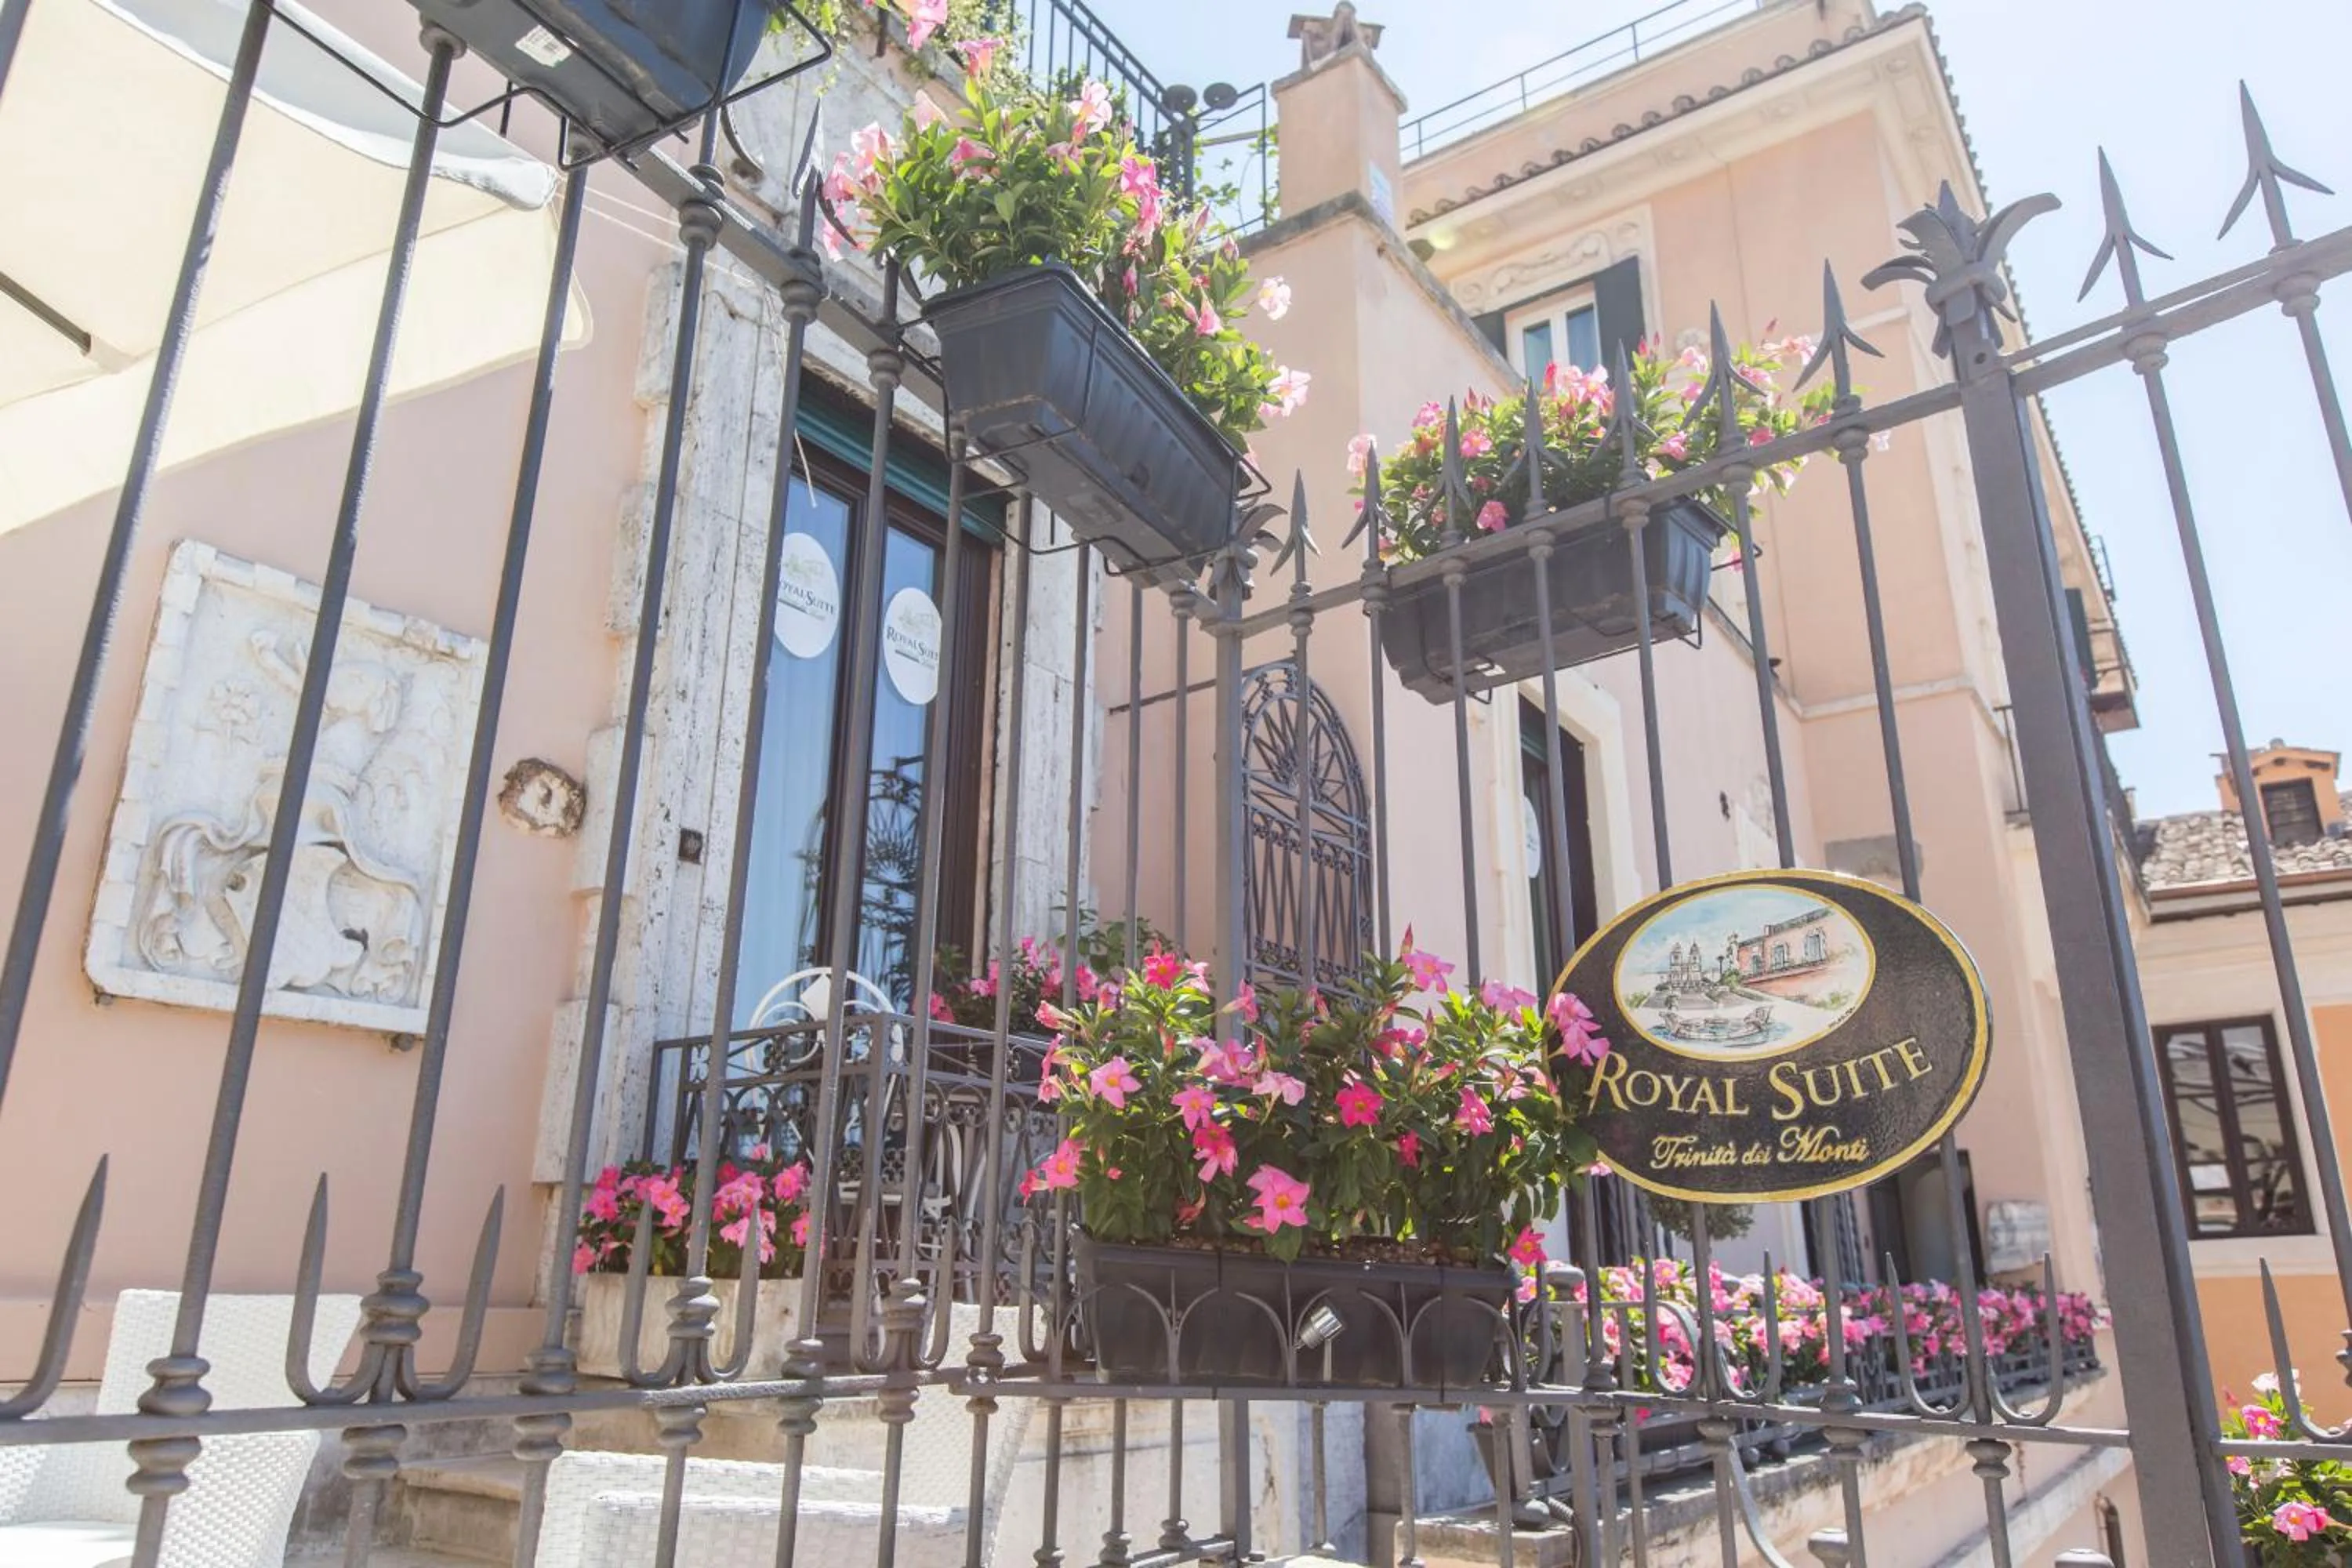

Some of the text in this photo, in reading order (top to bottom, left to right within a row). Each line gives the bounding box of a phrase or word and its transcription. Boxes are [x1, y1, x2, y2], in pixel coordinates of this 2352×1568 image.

[887, 625, 916, 650] ROYAL
[1584, 1036, 1933, 1121] ROYAL SUITE
[1650, 1127, 1870, 1170] Trinità dei Monti
